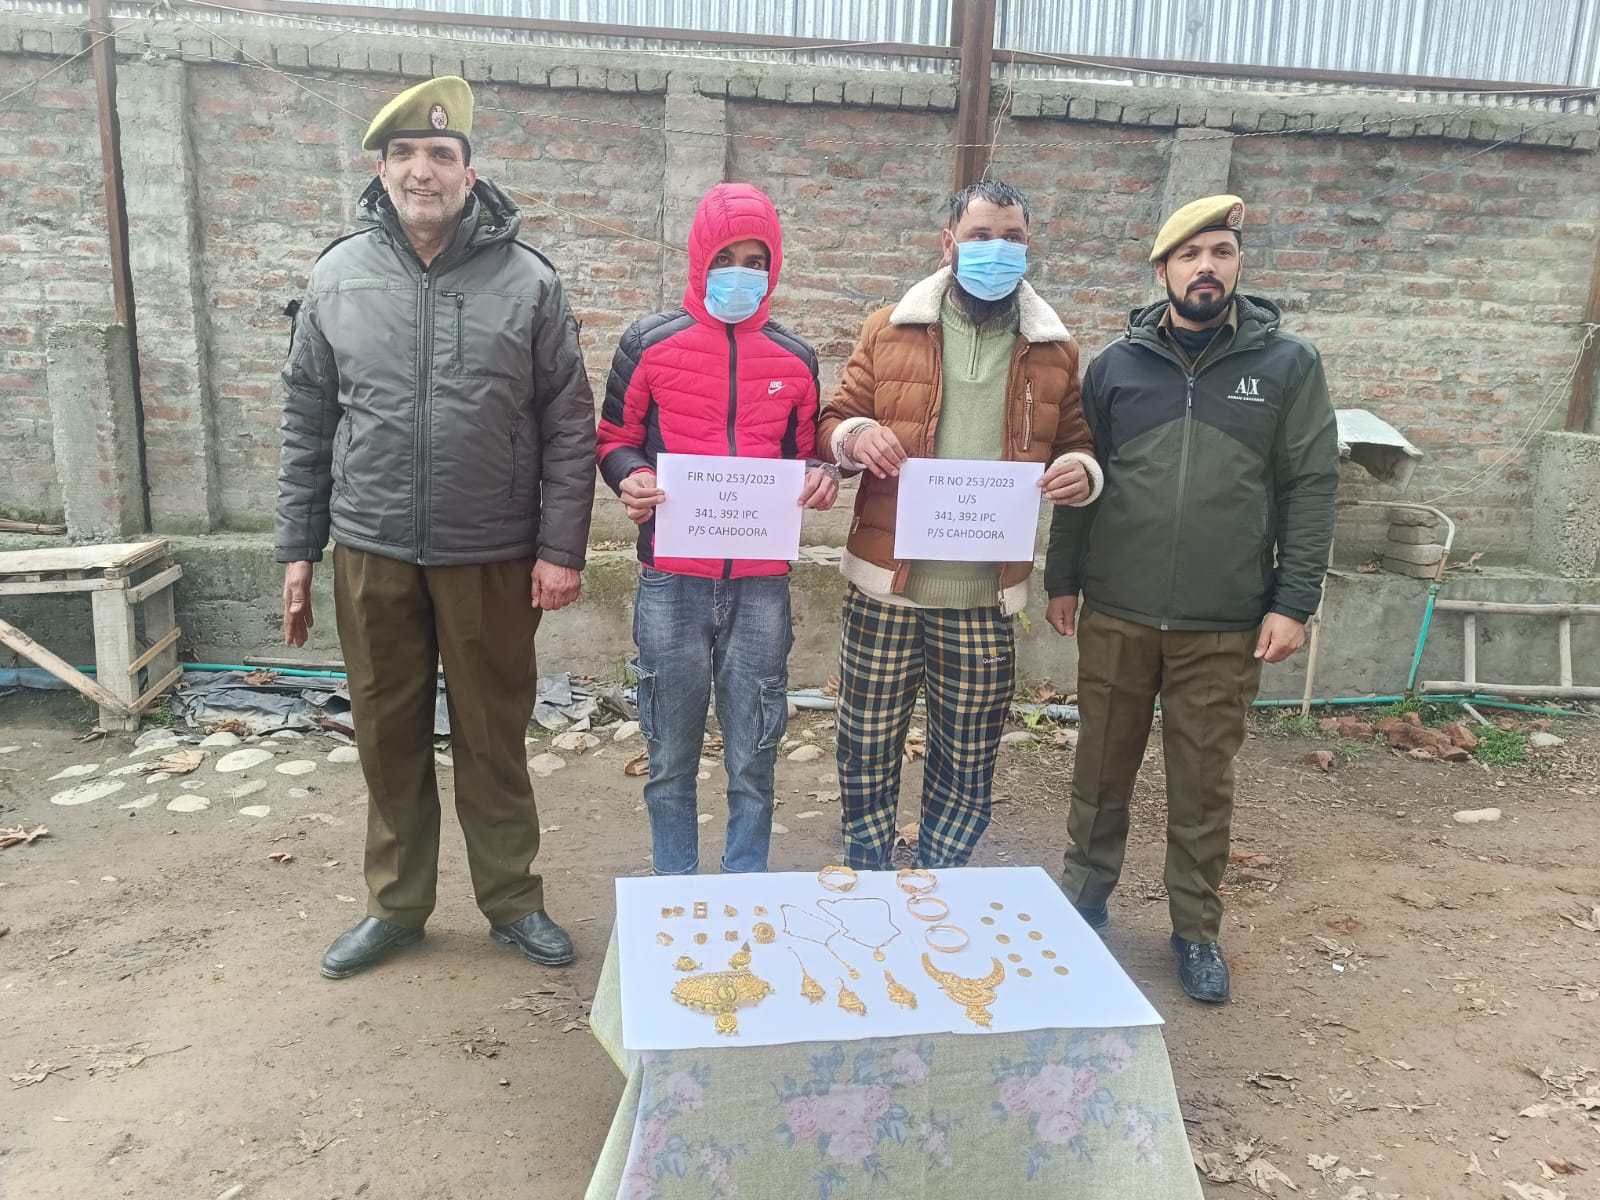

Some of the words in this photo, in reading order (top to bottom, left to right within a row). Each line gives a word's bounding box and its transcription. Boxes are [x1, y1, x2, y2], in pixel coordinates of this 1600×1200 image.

[688, 471, 704, 482] FIR
[706, 472, 723, 483] NO
[726, 473, 776, 485] 253/2023
[928, 475, 945, 486] FIR
[947, 476, 963, 486] NO
[966, 477, 1015, 488] 253/2023
[719, 490, 738, 502] U/S
[958, 494, 977, 505] U/S
[695, 508, 717, 519] 341,
[720, 509, 739, 519] 392
[742, 510, 759, 520] IPC
[934, 510, 956, 522] 341,
[958, 512, 977, 522] 392
[980, 513, 997, 522] IPC
[688, 525, 706, 536] P/S
[708, 526, 768, 537] CAHDOORA
[927, 527, 944, 538] P/S
[947, 528, 1005, 539] CAHDOORA
